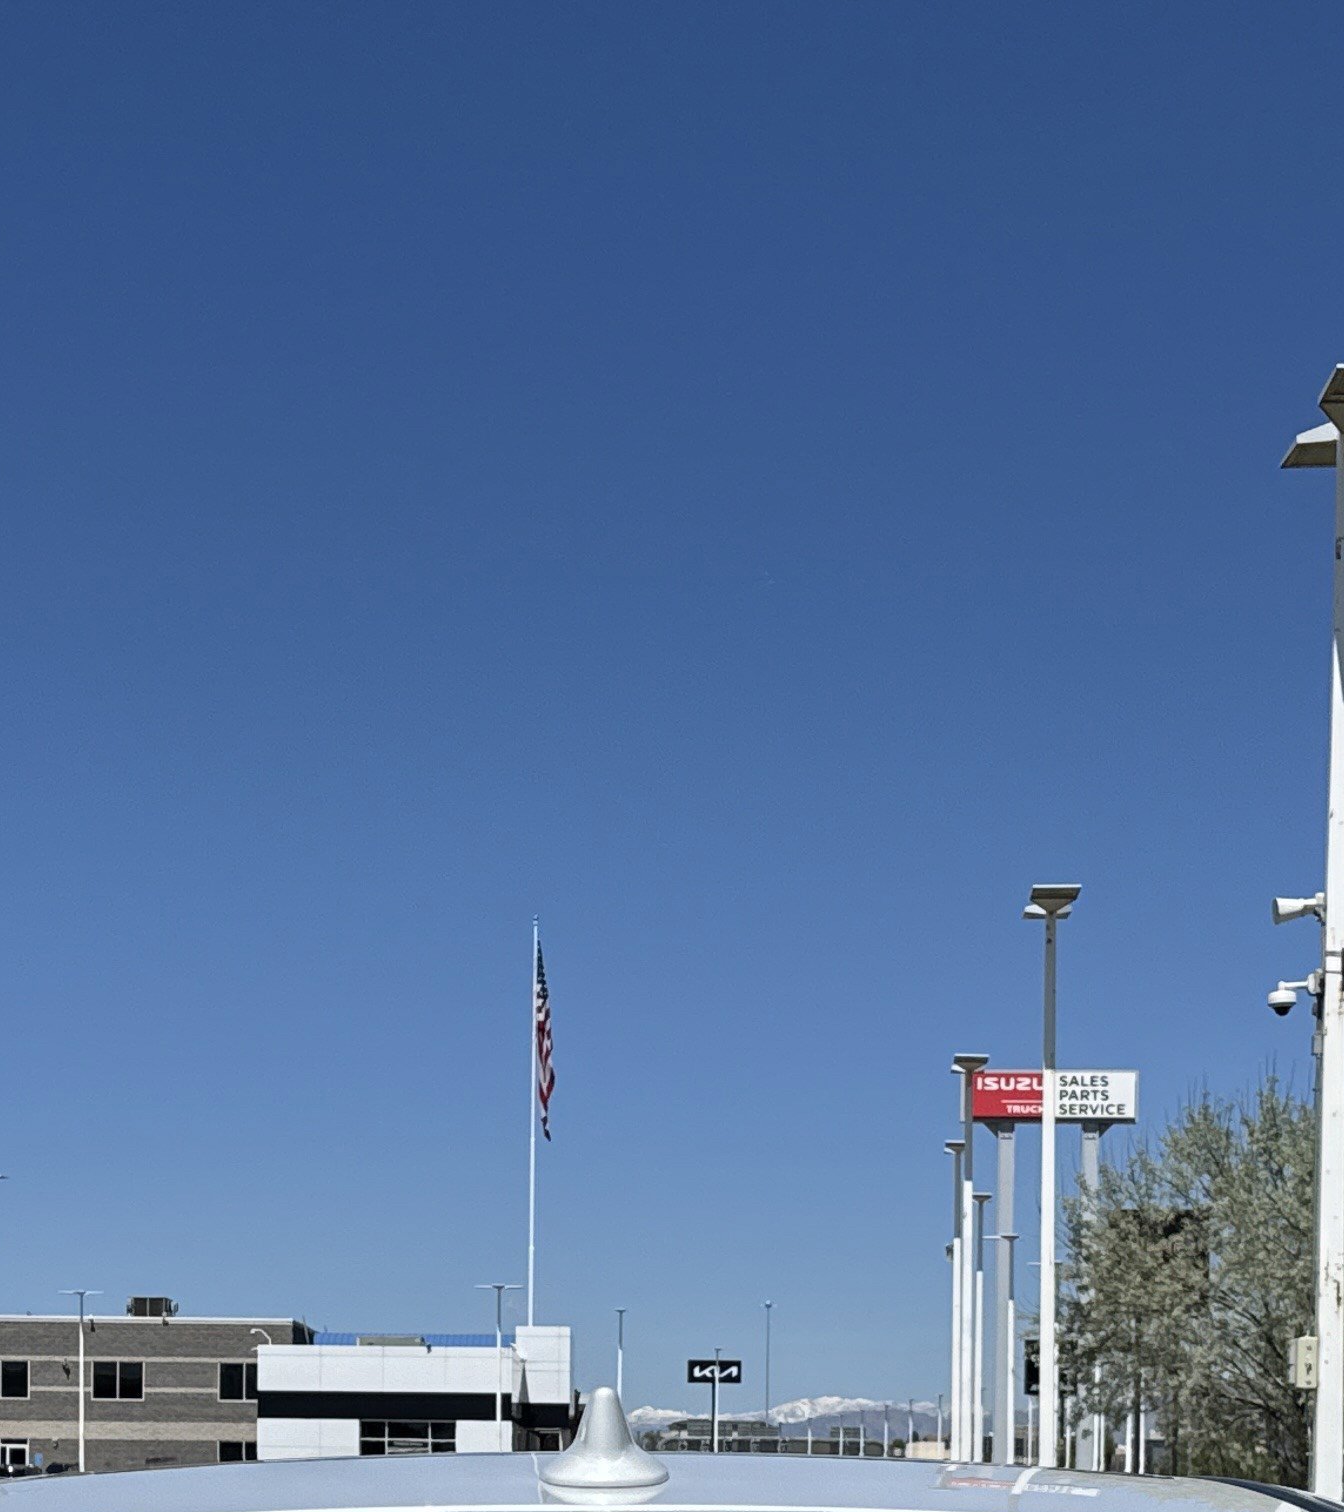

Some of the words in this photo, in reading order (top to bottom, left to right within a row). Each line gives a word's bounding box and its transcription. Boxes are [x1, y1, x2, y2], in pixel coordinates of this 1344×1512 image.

[977, 1077, 1043, 1090] ISUZU
[1059, 1076, 1109, 1087] SALES
[1059, 1090, 1109, 1101] PARTS
[1059, 1104, 1126, 1115] SERVICE
